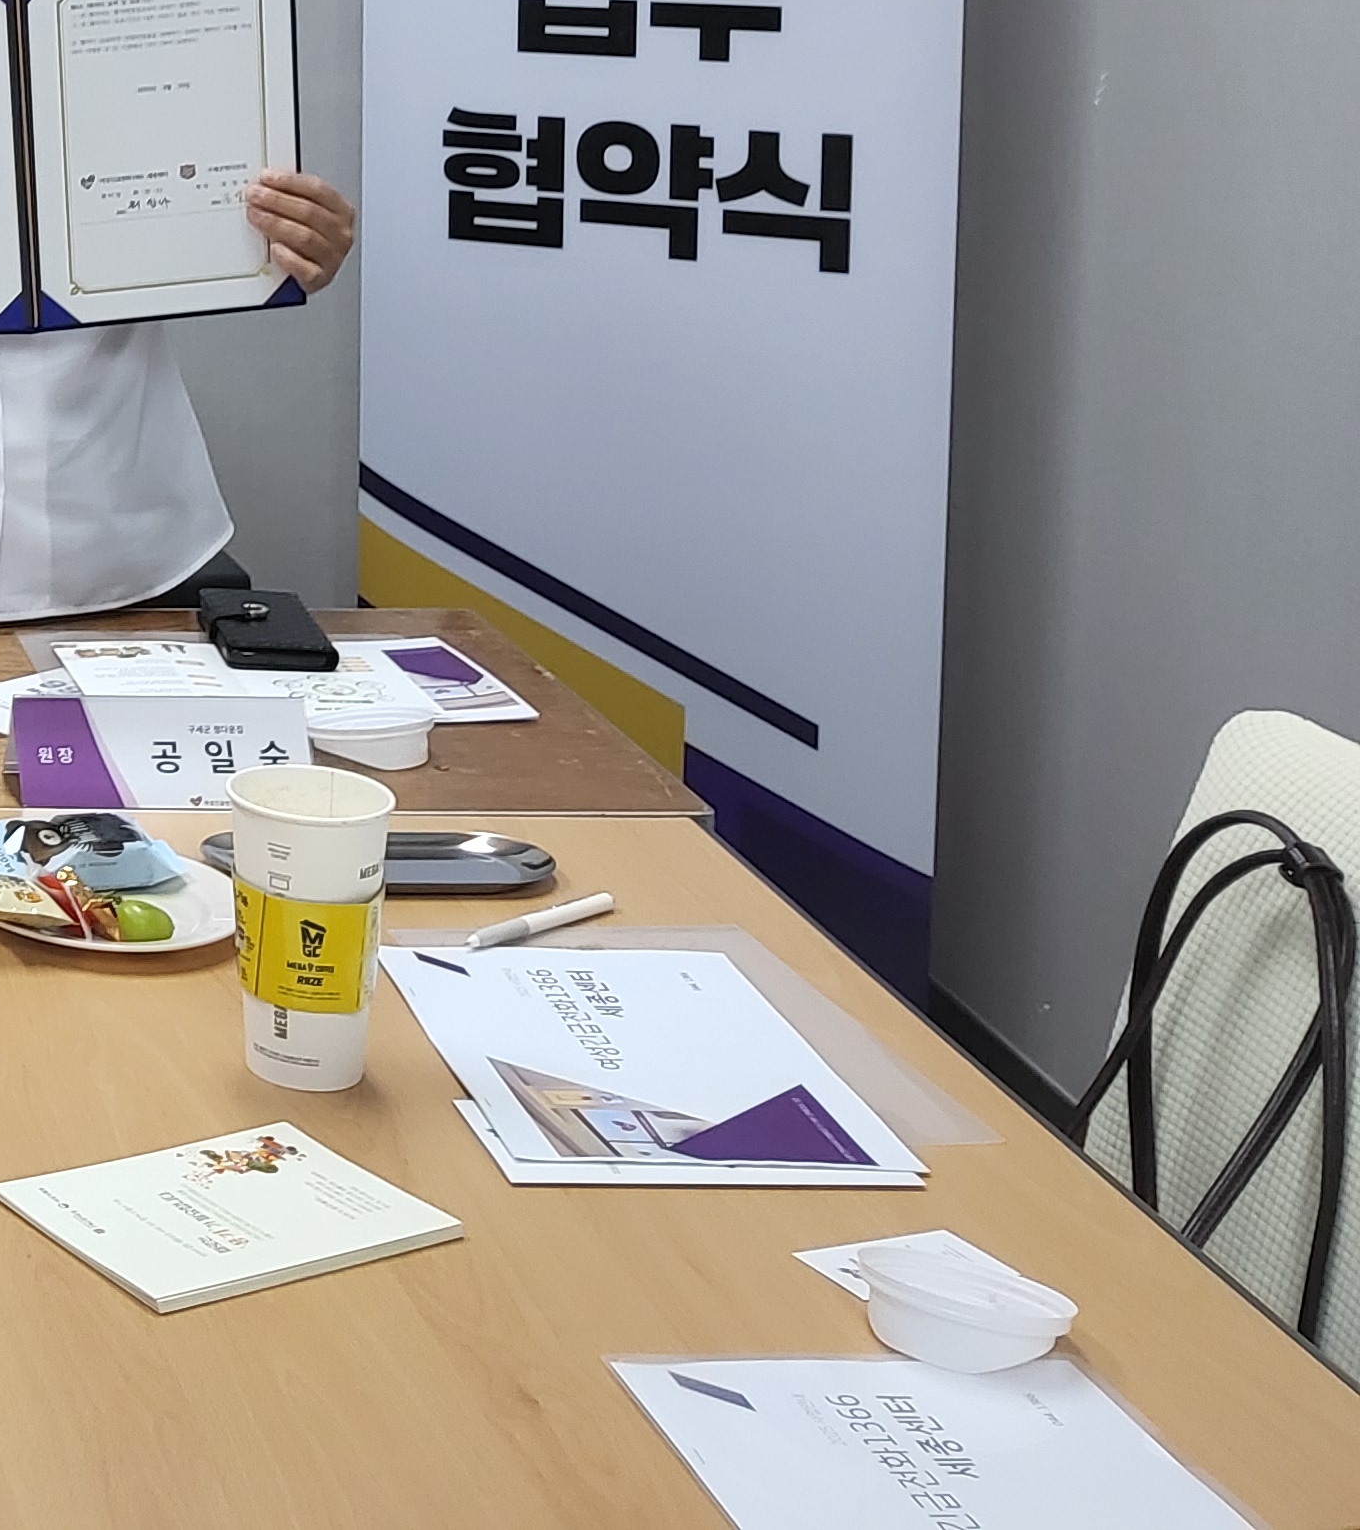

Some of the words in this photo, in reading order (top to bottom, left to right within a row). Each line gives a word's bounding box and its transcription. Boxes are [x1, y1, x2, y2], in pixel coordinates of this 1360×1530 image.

[442, 106, 854, 274] 협약식
[37, 745, 74, 765] 원장
[524, 968, 626, 1072] 여성긴급전화1366
[564, 969, 626, 1019] 세종센터
[824, 1392, 982, 1530] 긴급전화1366
[875, 1392, 982, 1480] 세종센터
